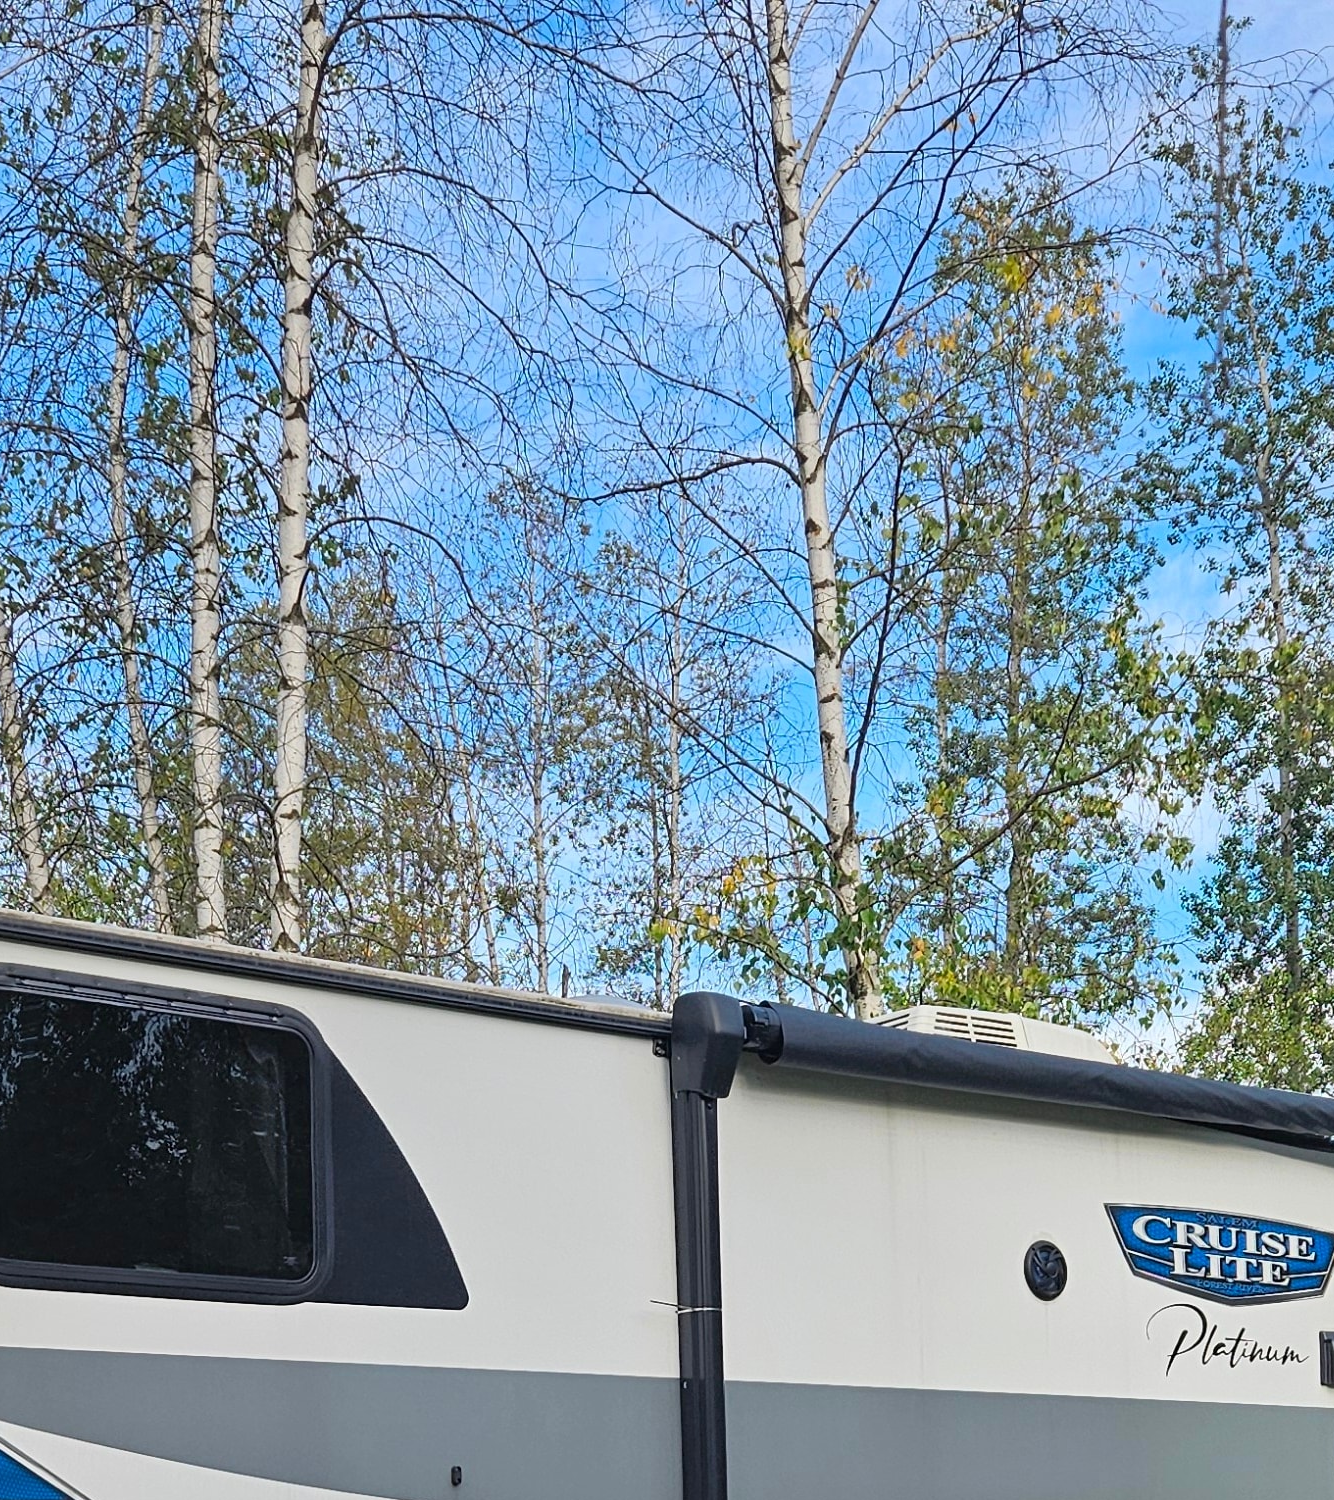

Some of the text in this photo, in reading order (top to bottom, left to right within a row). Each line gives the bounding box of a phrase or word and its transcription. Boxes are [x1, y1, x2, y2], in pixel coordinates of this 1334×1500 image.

[1132, 1215, 1316, 1261] CRUISE
[1196, 1211, 1260, 1230] SALEM
[1168, 1247, 1291, 1287] LITE
[1197, 1279, 1267, 1294] FOREST RIVER
[1146, 1303, 1310, 1377] Platinum
